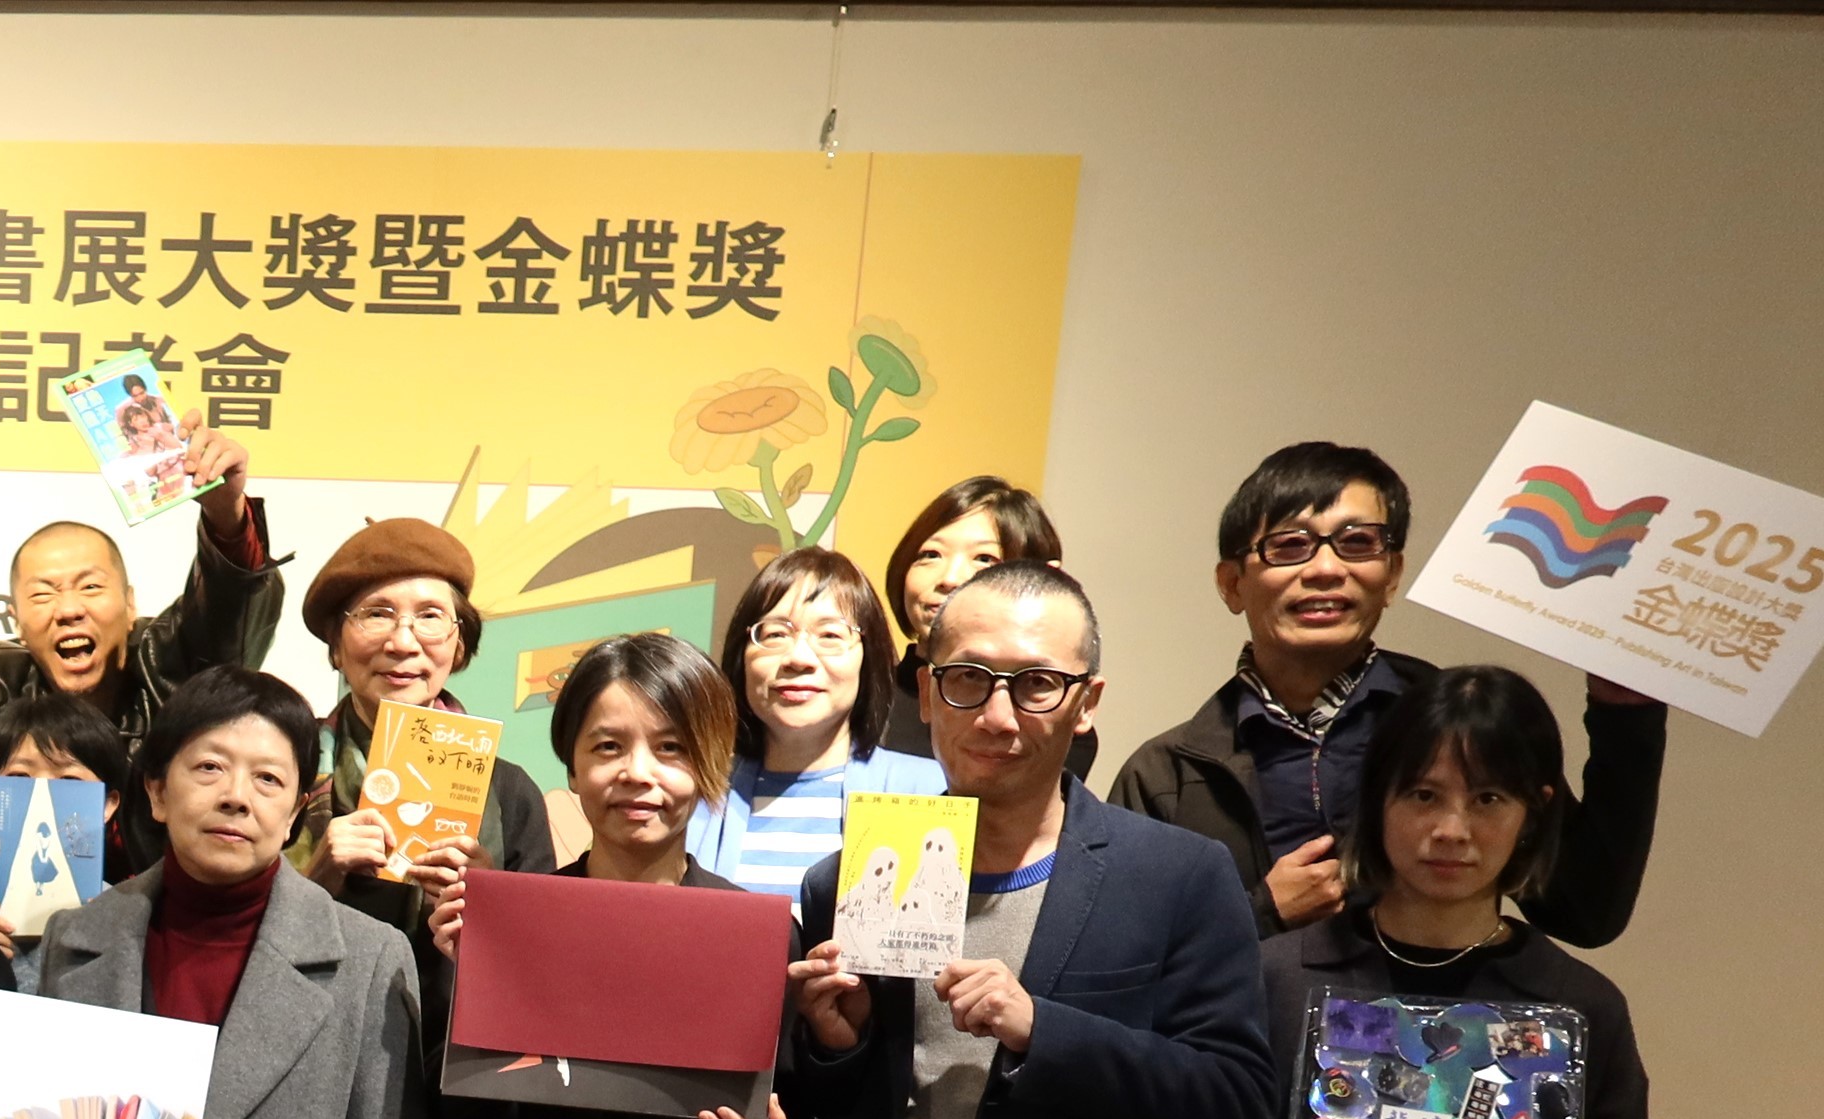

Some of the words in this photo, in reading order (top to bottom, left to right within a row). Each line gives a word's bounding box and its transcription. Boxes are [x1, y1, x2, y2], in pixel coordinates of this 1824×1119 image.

[1672, 509, 1824, 594] 2025
[1452, 573, 1493, 595] Golden
[1494, 589, 1538, 613] Butterfly
[1539, 607, 1578, 628] Award
[1674, 657, 1691, 674] Art
[1691, 665, 1704, 677] in
[1705, 670, 1749, 695] Taiwan
[1622, 584, 1786, 672] 金蝶獎
